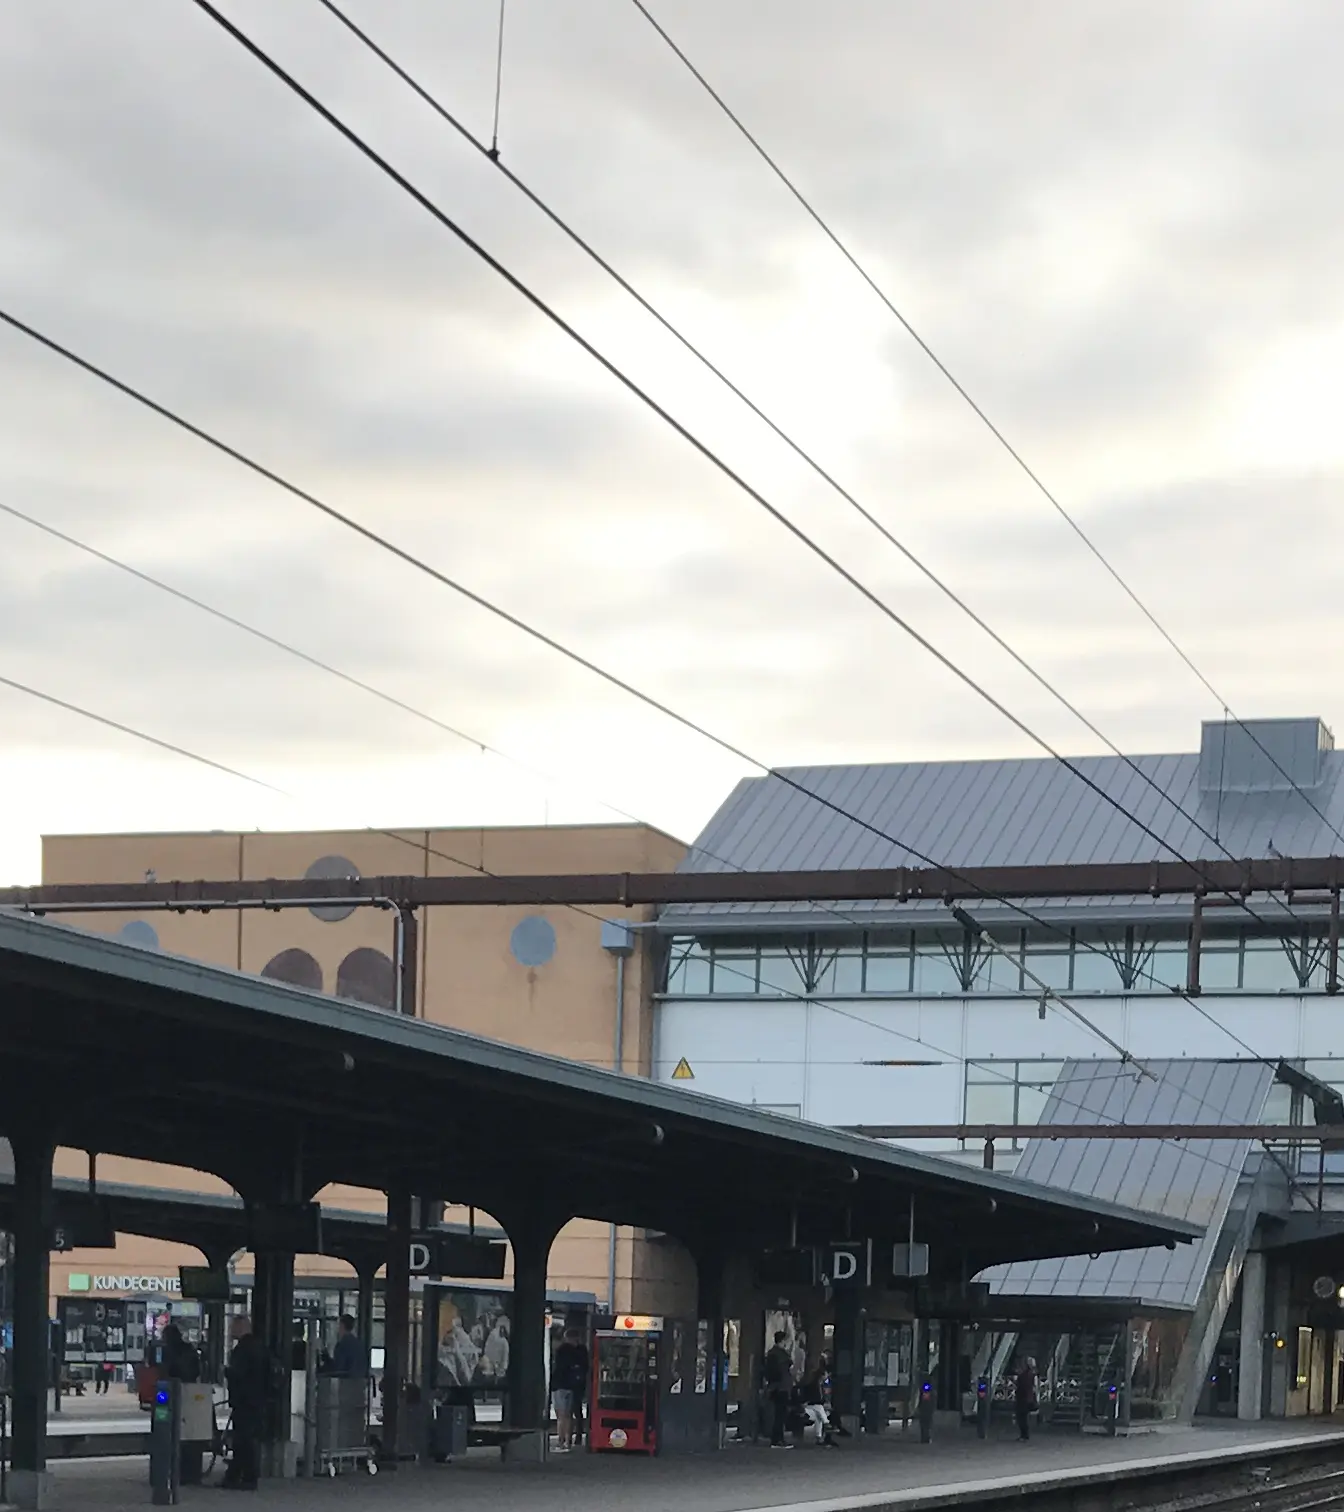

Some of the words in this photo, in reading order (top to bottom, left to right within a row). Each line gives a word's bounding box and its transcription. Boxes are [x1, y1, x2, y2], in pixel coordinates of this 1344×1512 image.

[409, 1243, 430, 1270] D
[833, 1251, 857, 1280] D
[94, 1276, 182, 1292] KUNDECENTE
